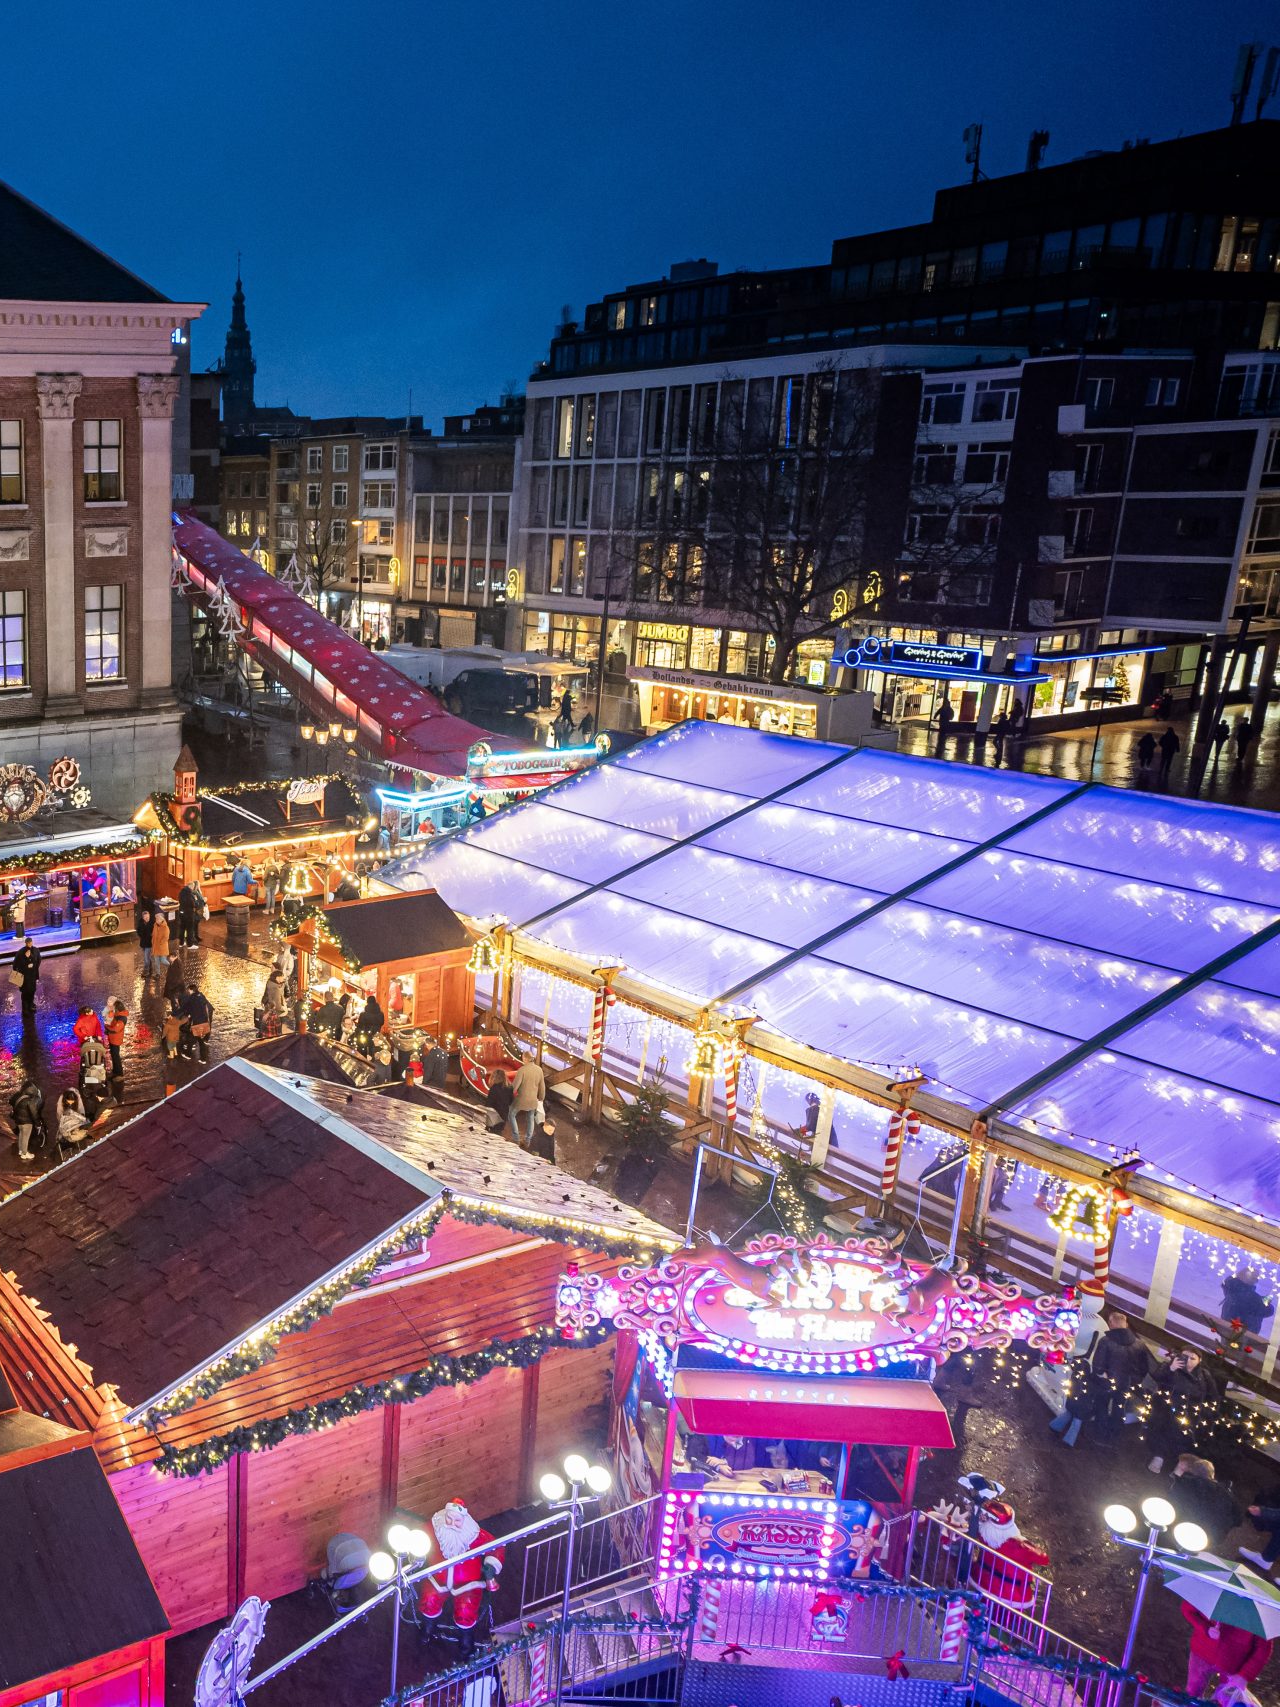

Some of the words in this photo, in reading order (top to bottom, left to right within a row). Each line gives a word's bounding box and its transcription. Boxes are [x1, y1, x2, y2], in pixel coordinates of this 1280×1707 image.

[639, 623, 689, 642] JUMBO
[652, 670, 696, 686] Hollandse
[713, 680, 774, 698] Gebakkraam
[738, 1523, 823, 1548] KASSA
